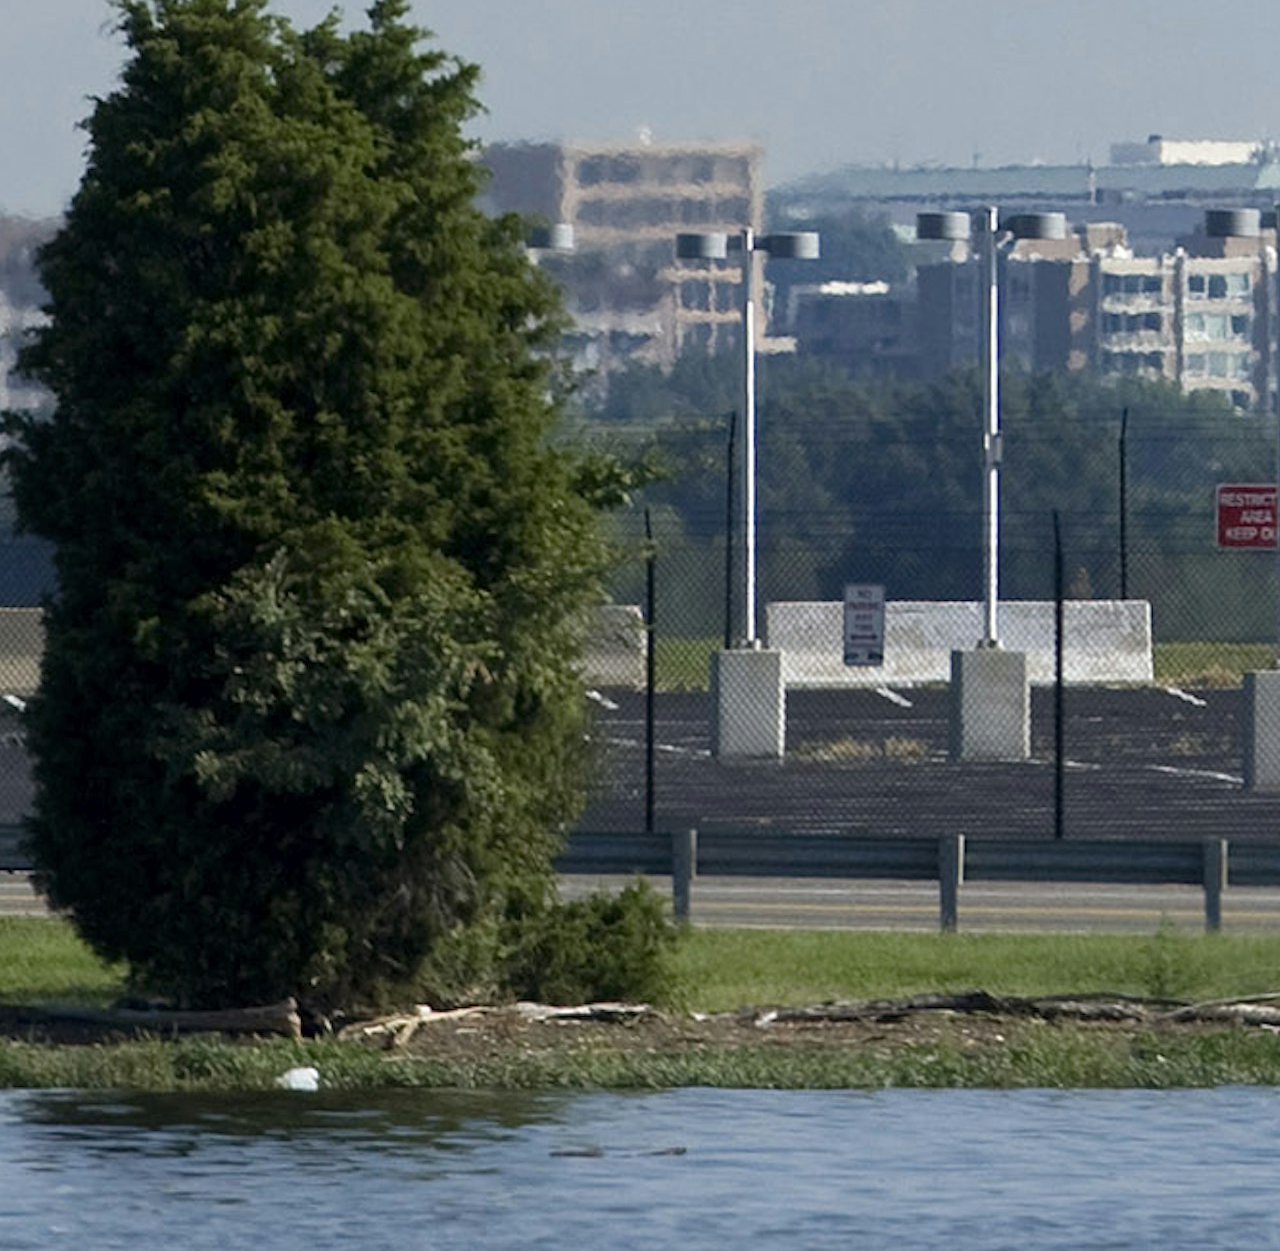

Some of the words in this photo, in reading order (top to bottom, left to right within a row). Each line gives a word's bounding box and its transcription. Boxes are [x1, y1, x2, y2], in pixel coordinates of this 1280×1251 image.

[1220, 492, 1276, 508] RESTRICT
[1240, 509, 1273, 524] AREA
[1225, 526, 1258, 540] KEEP
